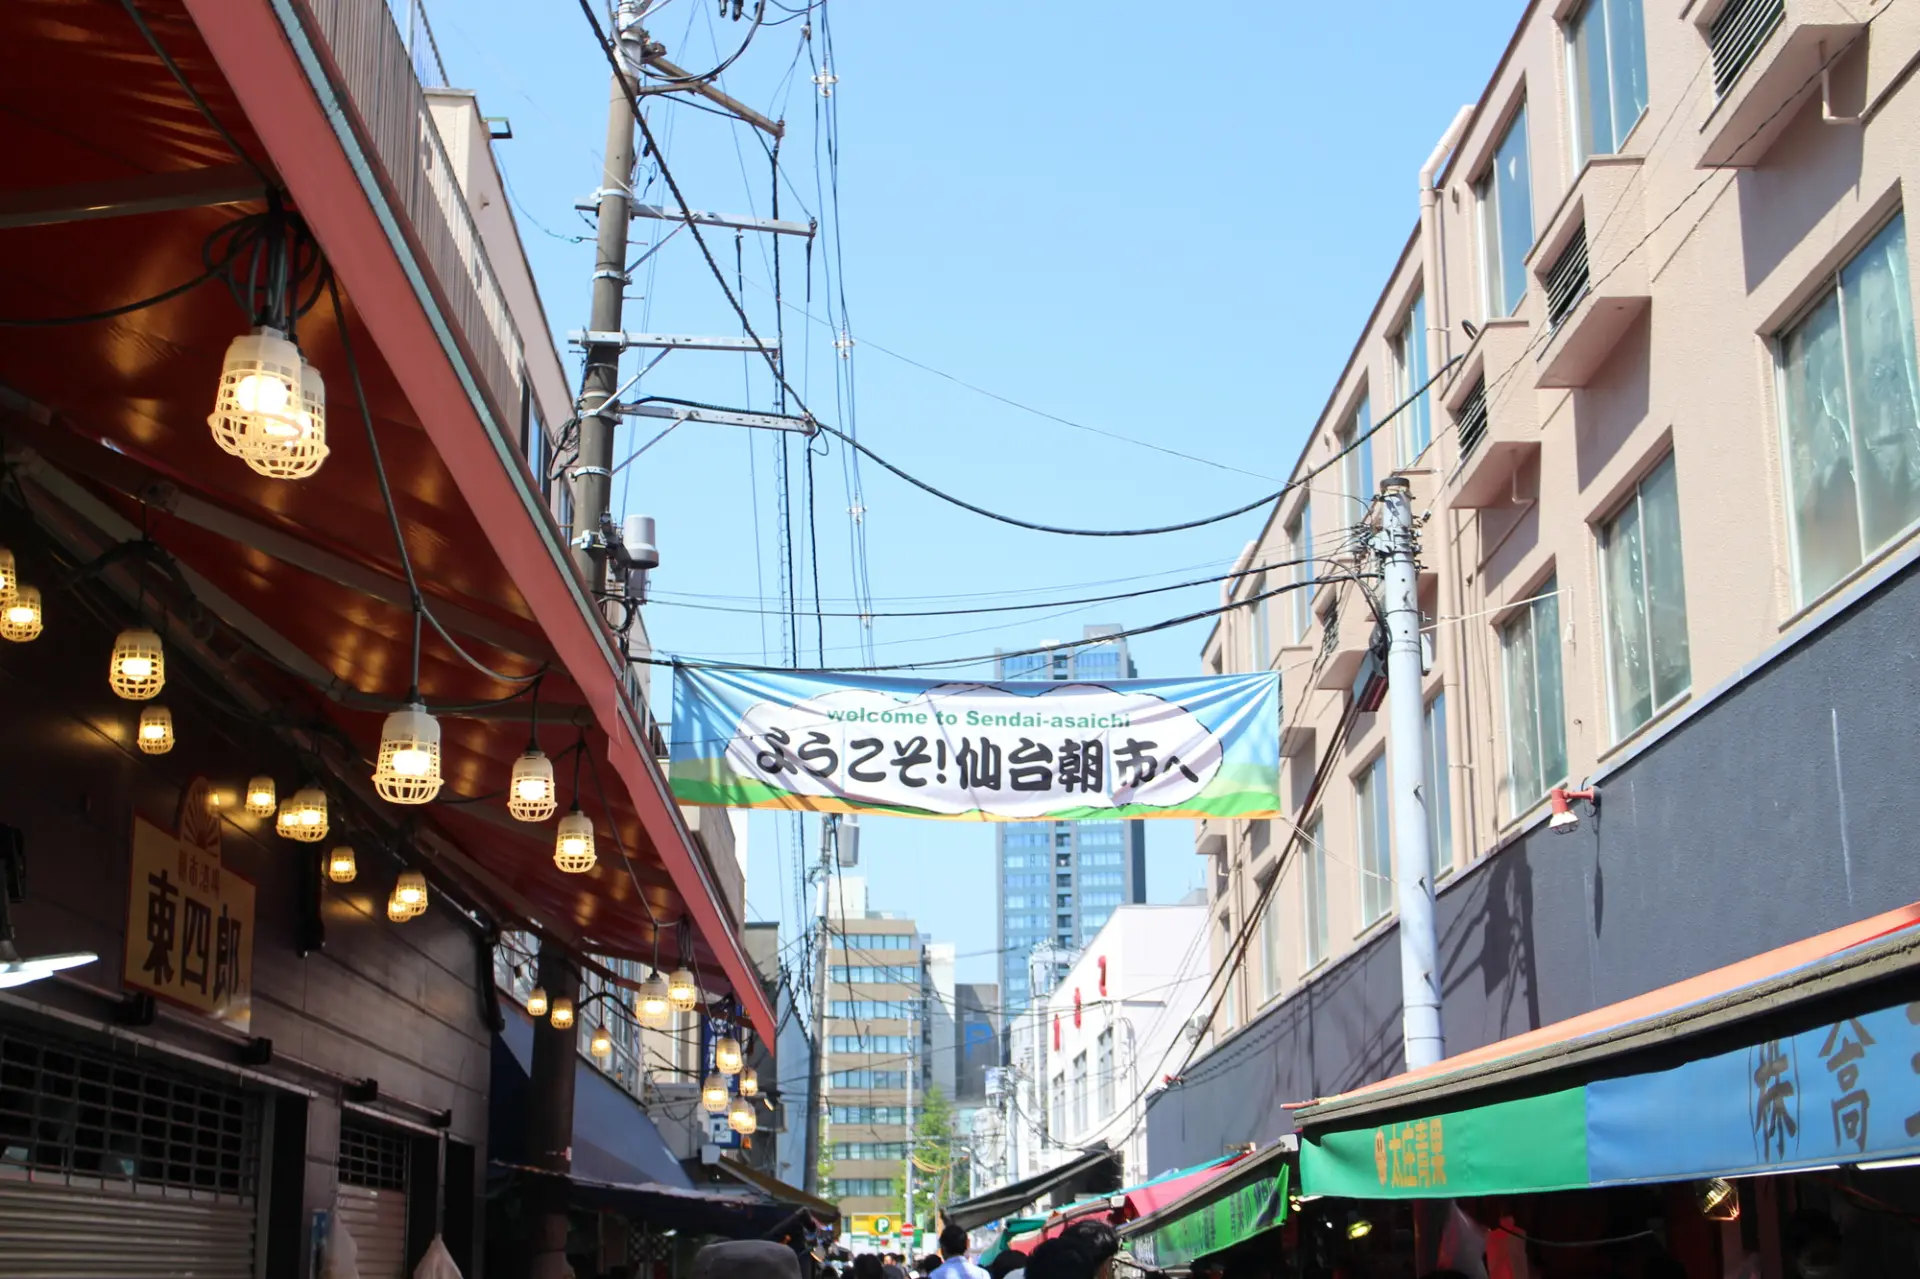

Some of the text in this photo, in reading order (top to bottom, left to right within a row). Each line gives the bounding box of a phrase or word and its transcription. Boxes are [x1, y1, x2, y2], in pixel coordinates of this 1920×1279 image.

[826, 707, 1131, 729] welcome to Sendai-asaichi
[756, 726, 1199, 793] ようこそ!仙台朝市へ
[142, 868, 242, 1006] 東四郎
[966, 1022, 993, 1062] P
[877, 1217, 889, 1232] P
